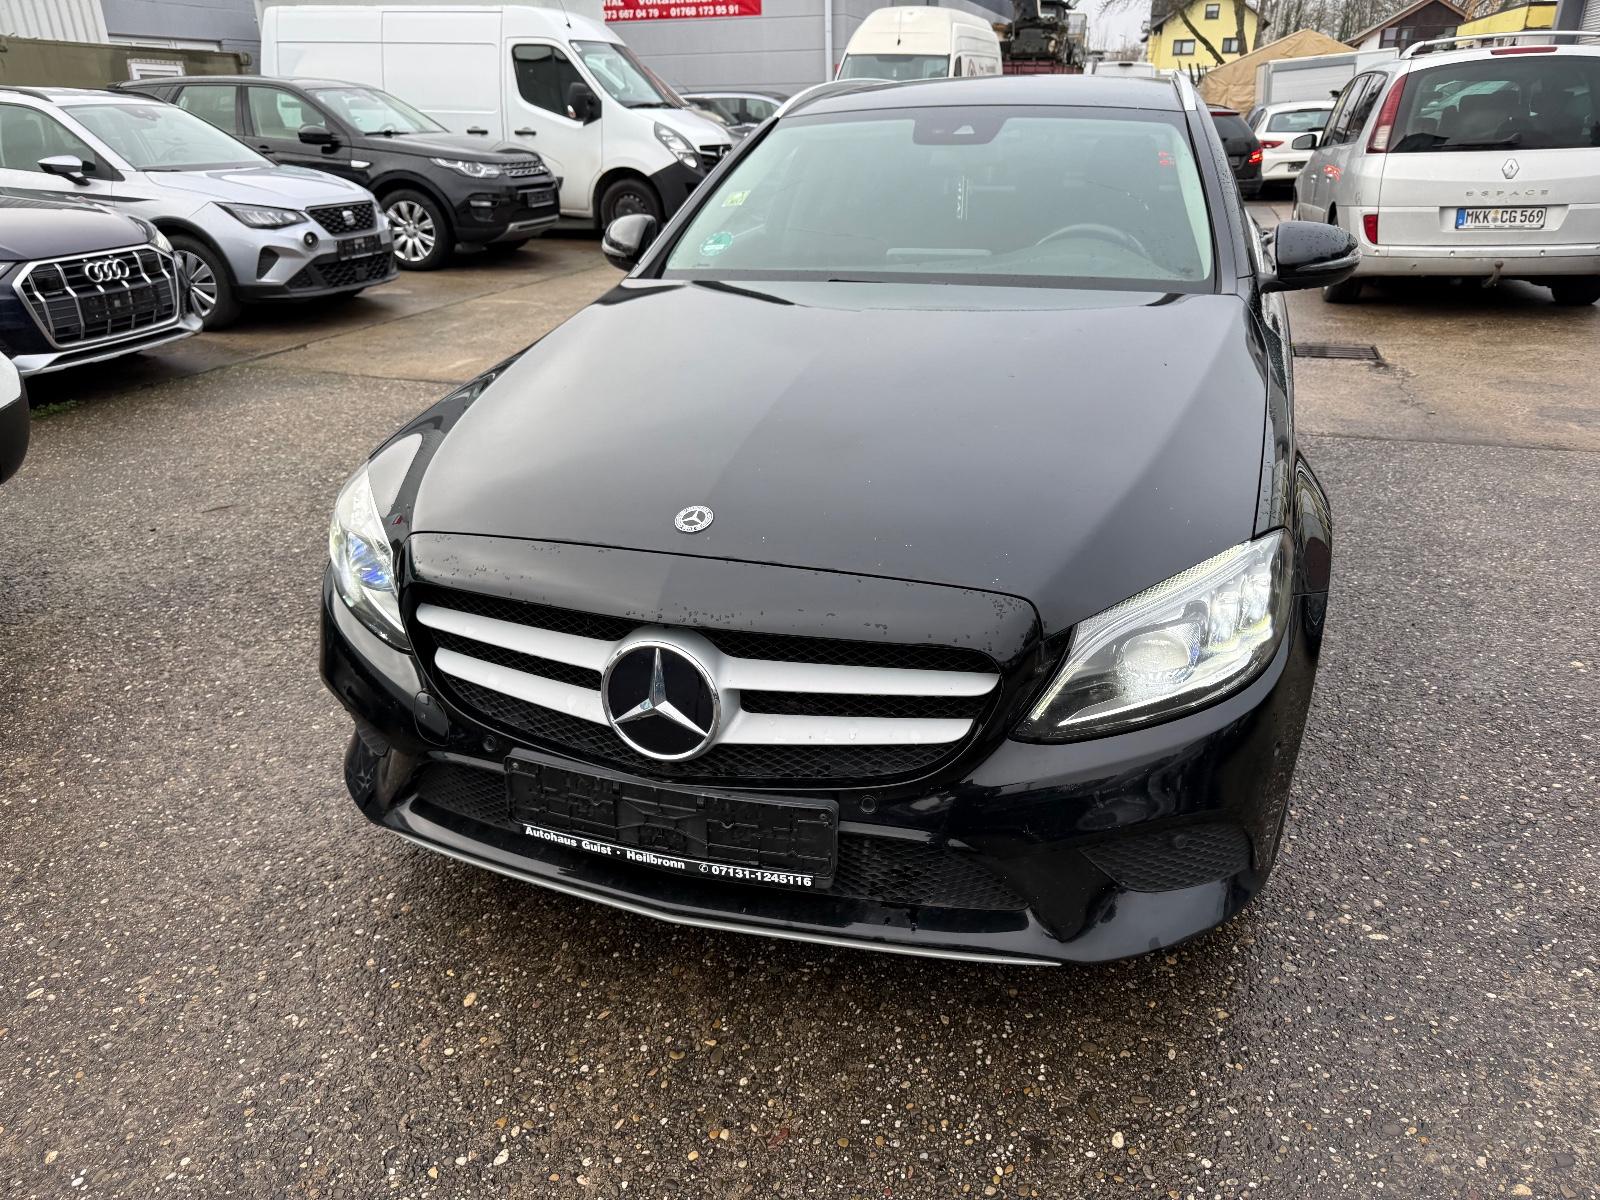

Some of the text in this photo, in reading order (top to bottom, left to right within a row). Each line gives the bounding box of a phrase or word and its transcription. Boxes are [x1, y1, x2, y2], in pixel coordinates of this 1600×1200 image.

[669, 6, 697, 17] 01768
[698, 5, 714, 16] 173
[728, 4, 739, 14] 91
[1466, 189, 1549, 197] ESPACE
[1465, 209, 1544, 224] MKK CG 569
[525, 826, 812, 887] Autohaus Guist Heilbronn 07131-1245116
